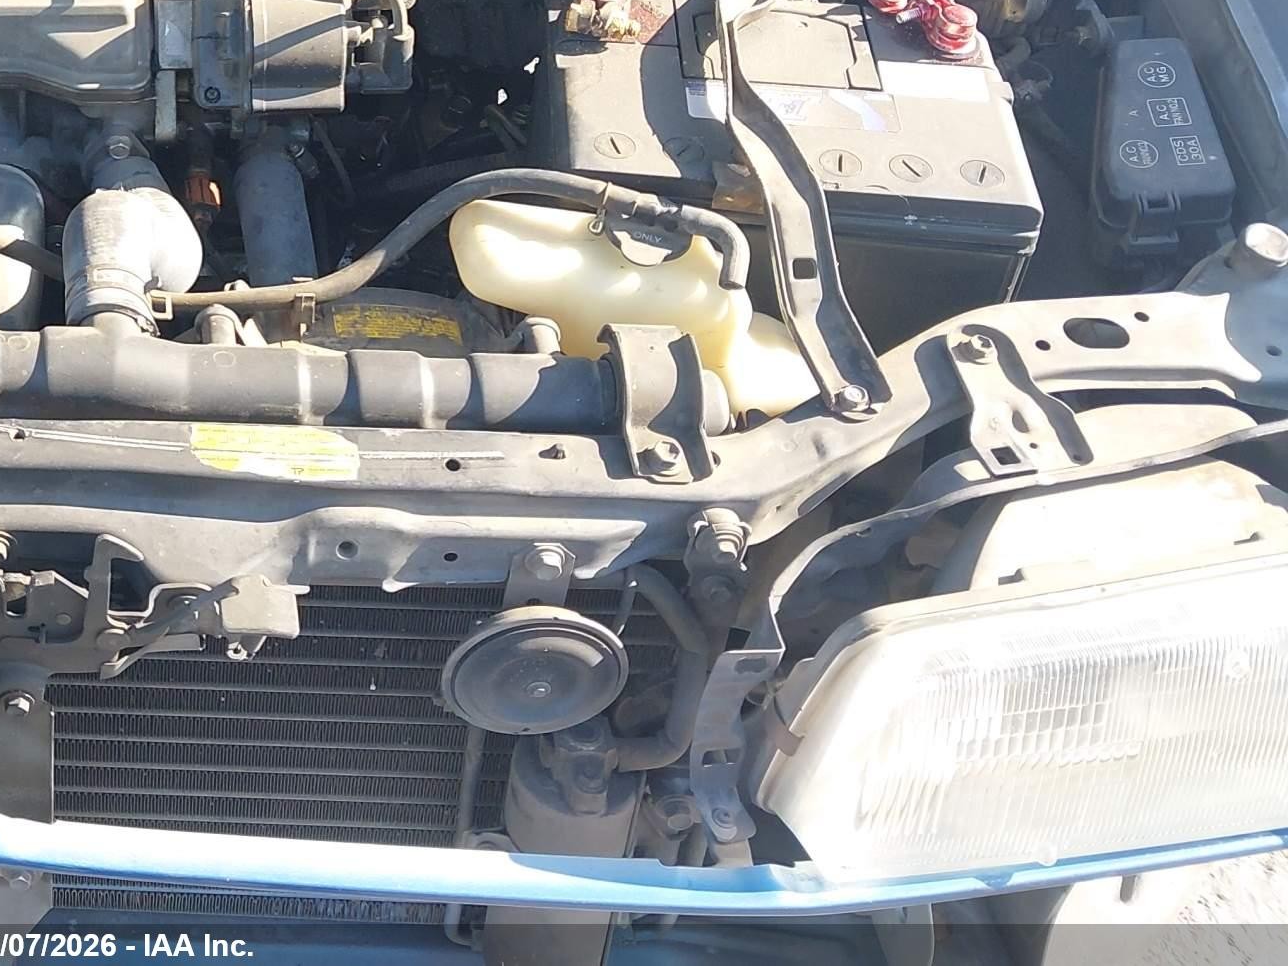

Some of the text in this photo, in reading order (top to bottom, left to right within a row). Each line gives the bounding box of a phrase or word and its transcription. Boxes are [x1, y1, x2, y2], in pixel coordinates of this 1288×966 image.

[1156, 66, 1170, 82] MG
[1175, 140, 1189, 161] CDS
[1189, 139, 1202, 160] 30A
[633, 231, 663, 243] ONLY
